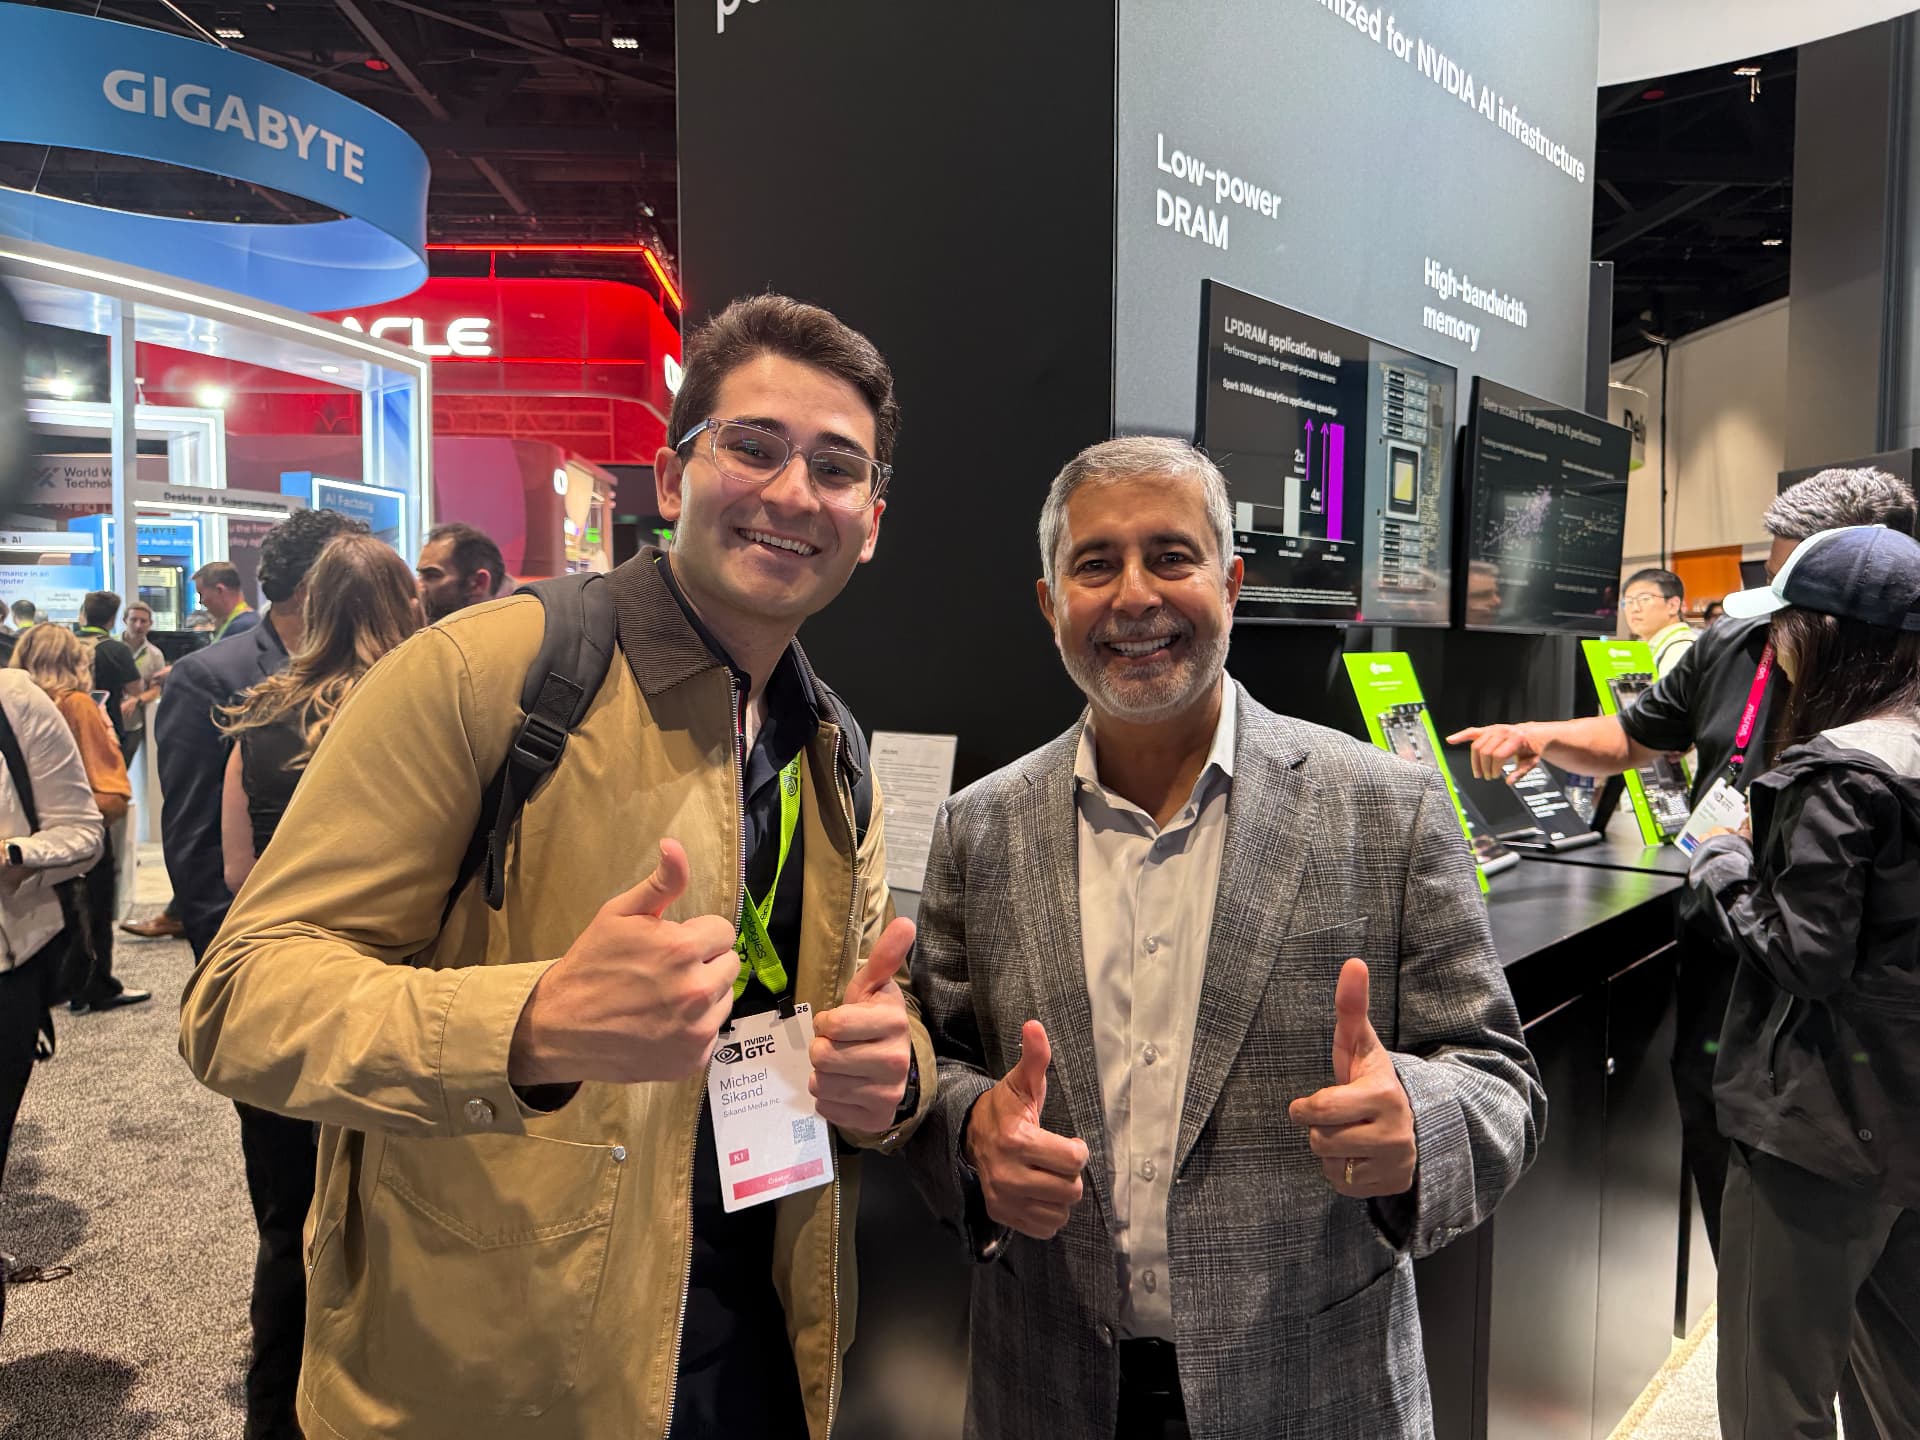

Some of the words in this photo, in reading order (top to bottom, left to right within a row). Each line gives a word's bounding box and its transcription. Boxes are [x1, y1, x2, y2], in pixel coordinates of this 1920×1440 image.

[1385, 16, 1414, 63] for
[1417, 38, 1476, 109] NVIDIA
[1478, 85, 1496, 122] AI
[1498, 96, 1586, 183] infrastructure
[102, 69, 365, 185] GIGABYTE
[1157, 132, 1282, 220] Low-power
[1156, 188, 1229, 251] DRAM
[1424, 256, 1528, 328] High-bandwidth
[1224, 316, 1268, 344] LPDRAM
[1268, 334, 1318, 360] application
[1318, 349, 1341, 367] value
[1423, 306, 1480, 352] memory
[1223, 342, 1258, 362] Performance
[1222, 378, 1239, 392] Spark
[1253, 387, 1266, 398] data
[64, 467, 98, 478] World
[102, 468, 112, 478] W
[65, 479, 112, 489] Technol
[745, 1042, 776, 1059] GTC
[719, 1067, 768, 1092] Michael
[721, 1084, 764, 1106] Sikand
[723, 1105, 747, 1118] Sikand
[747, 1101, 769, 1112] Media
[769, 1097, 781, 1106] Inc.
